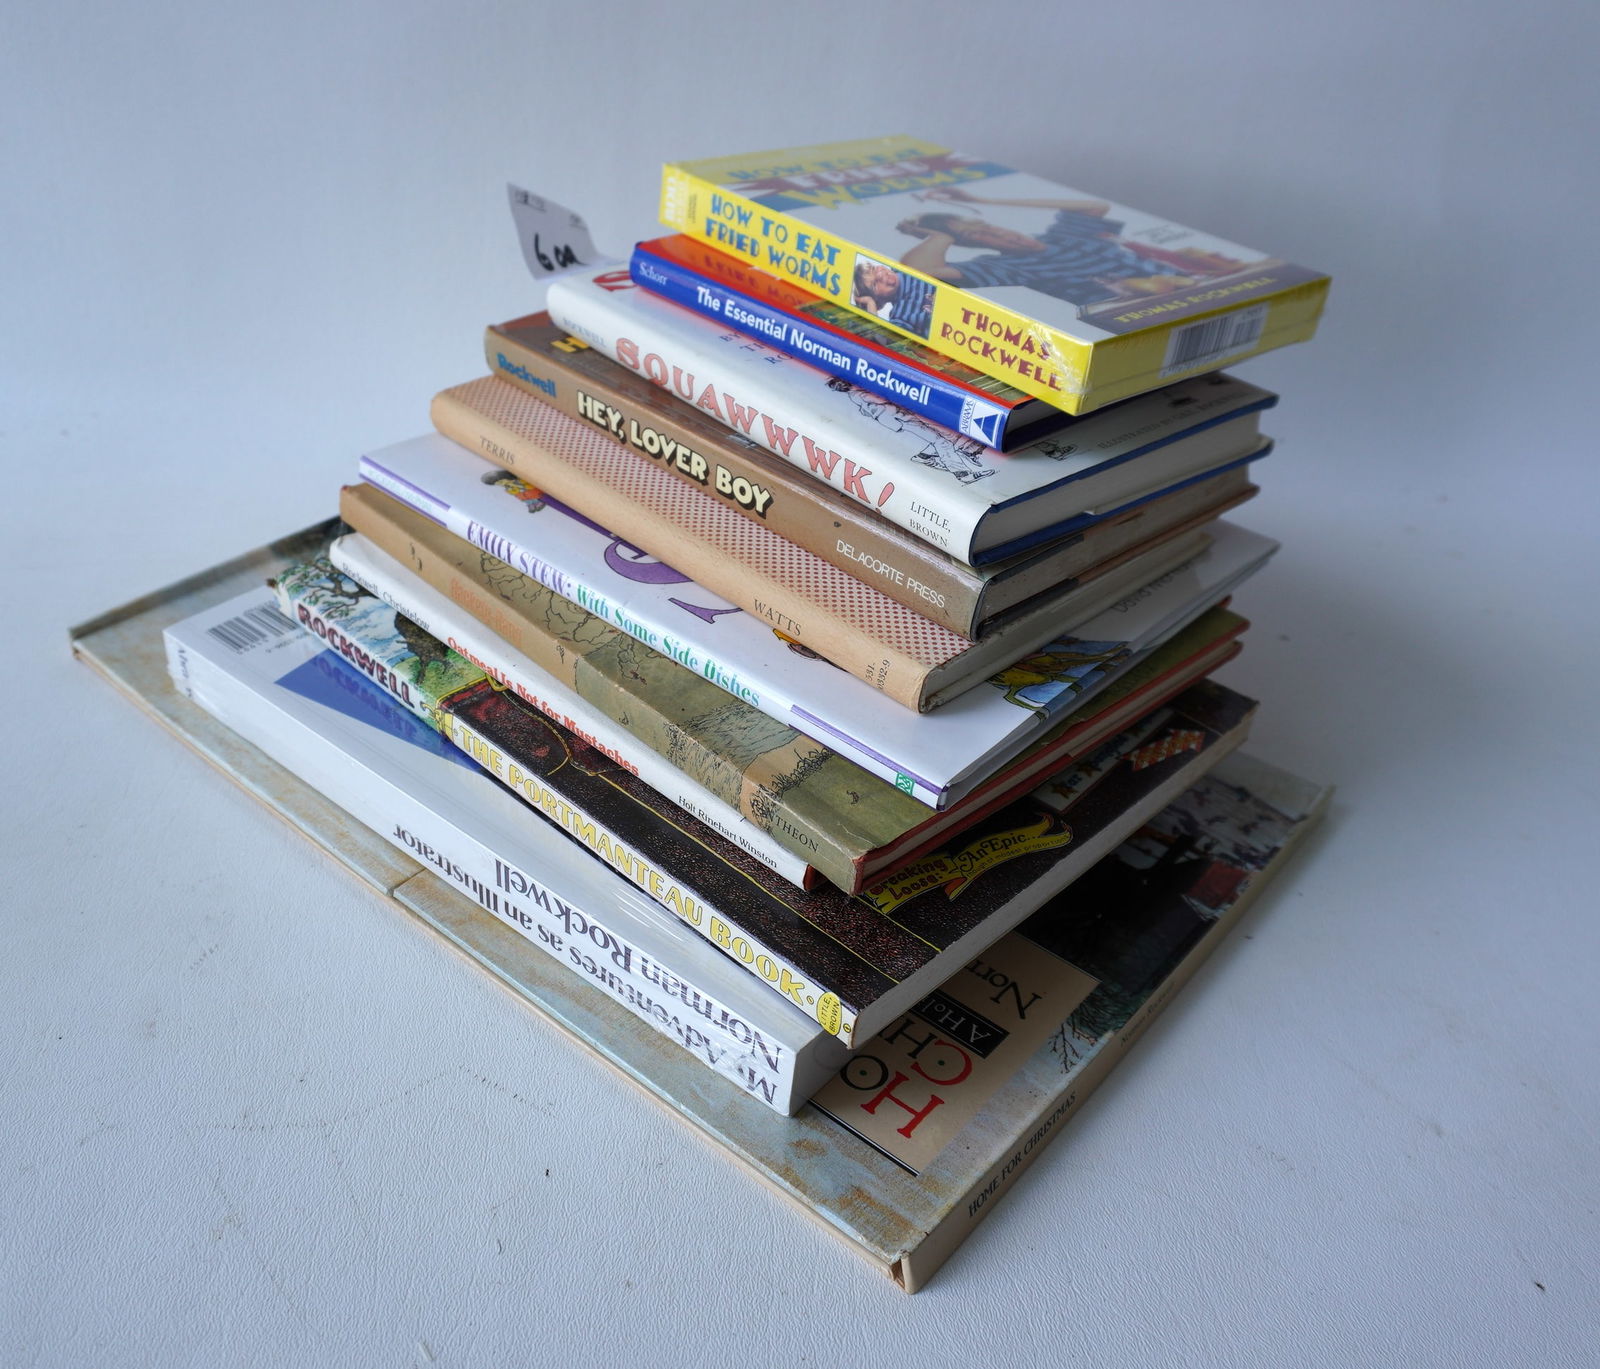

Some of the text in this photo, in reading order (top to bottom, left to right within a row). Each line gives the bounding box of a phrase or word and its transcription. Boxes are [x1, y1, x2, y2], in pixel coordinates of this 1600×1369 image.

[727, 162, 801, 181] HOW
[705, 217, 842, 297] FRIED WORMS
[710, 193, 753, 228] HOW
[761, 215, 788, 243] TO
[796, 231, 841, 266] EAT
[960, 306, 1052, 361] THOMAS
[1113, 275, 1278, 324] THOMAS ROCKWELL
[497, 352, 556, 398] Rockwell
[697, 285, 931, 406] The Essential Norman Rockwell
[940, 322, 1063, 392] ROCKWELL
[479, 435, 516, 466] TERRIS
[577, 390, 774, 520] HEY, LOVER BOY
[908, 518, 948, 548] BROWN
[910, 501, 951, 533] LITTLE,
[836, 539, 946, 609] DELACORTE PRESS
[467, 519, 519, 566] EMILY
[520, 551, 573, 598] STEW:
[577, 584, 609, 620] With
[613, 604, 657, 647] Some
[662, 630, 699, 672] Side
[703, 659, 760, 708] Dishes
[753, 599, 802, 637] WATTS
[297, 602, 417, 710] ROCKWELL
[448, 636, 640, 777] Oatmeal Is Not for Mustaches
[678, 794, 778, 869] Holt Rinehart Winston
[756, 798, 819, 853] NTHEON
[957, 845, 989, 873] An
[392, 823, 500, 912] Illustrator
[459, 725, 805, 1007] THE PORTMANTEAU BOOK
[502, 899, 534, 932] an
[537, 923, 564, 955] as
[494, 858, 781, 1074] Norman Rockwell
[567, 945, 728, 1069] Adventures
[820, 995, 834, 1028] LITTLE,
[828, 1000, 841, 1034] BROWN
[967, 1091, 1077, 1218] HOME FOR CHRISTMAS
